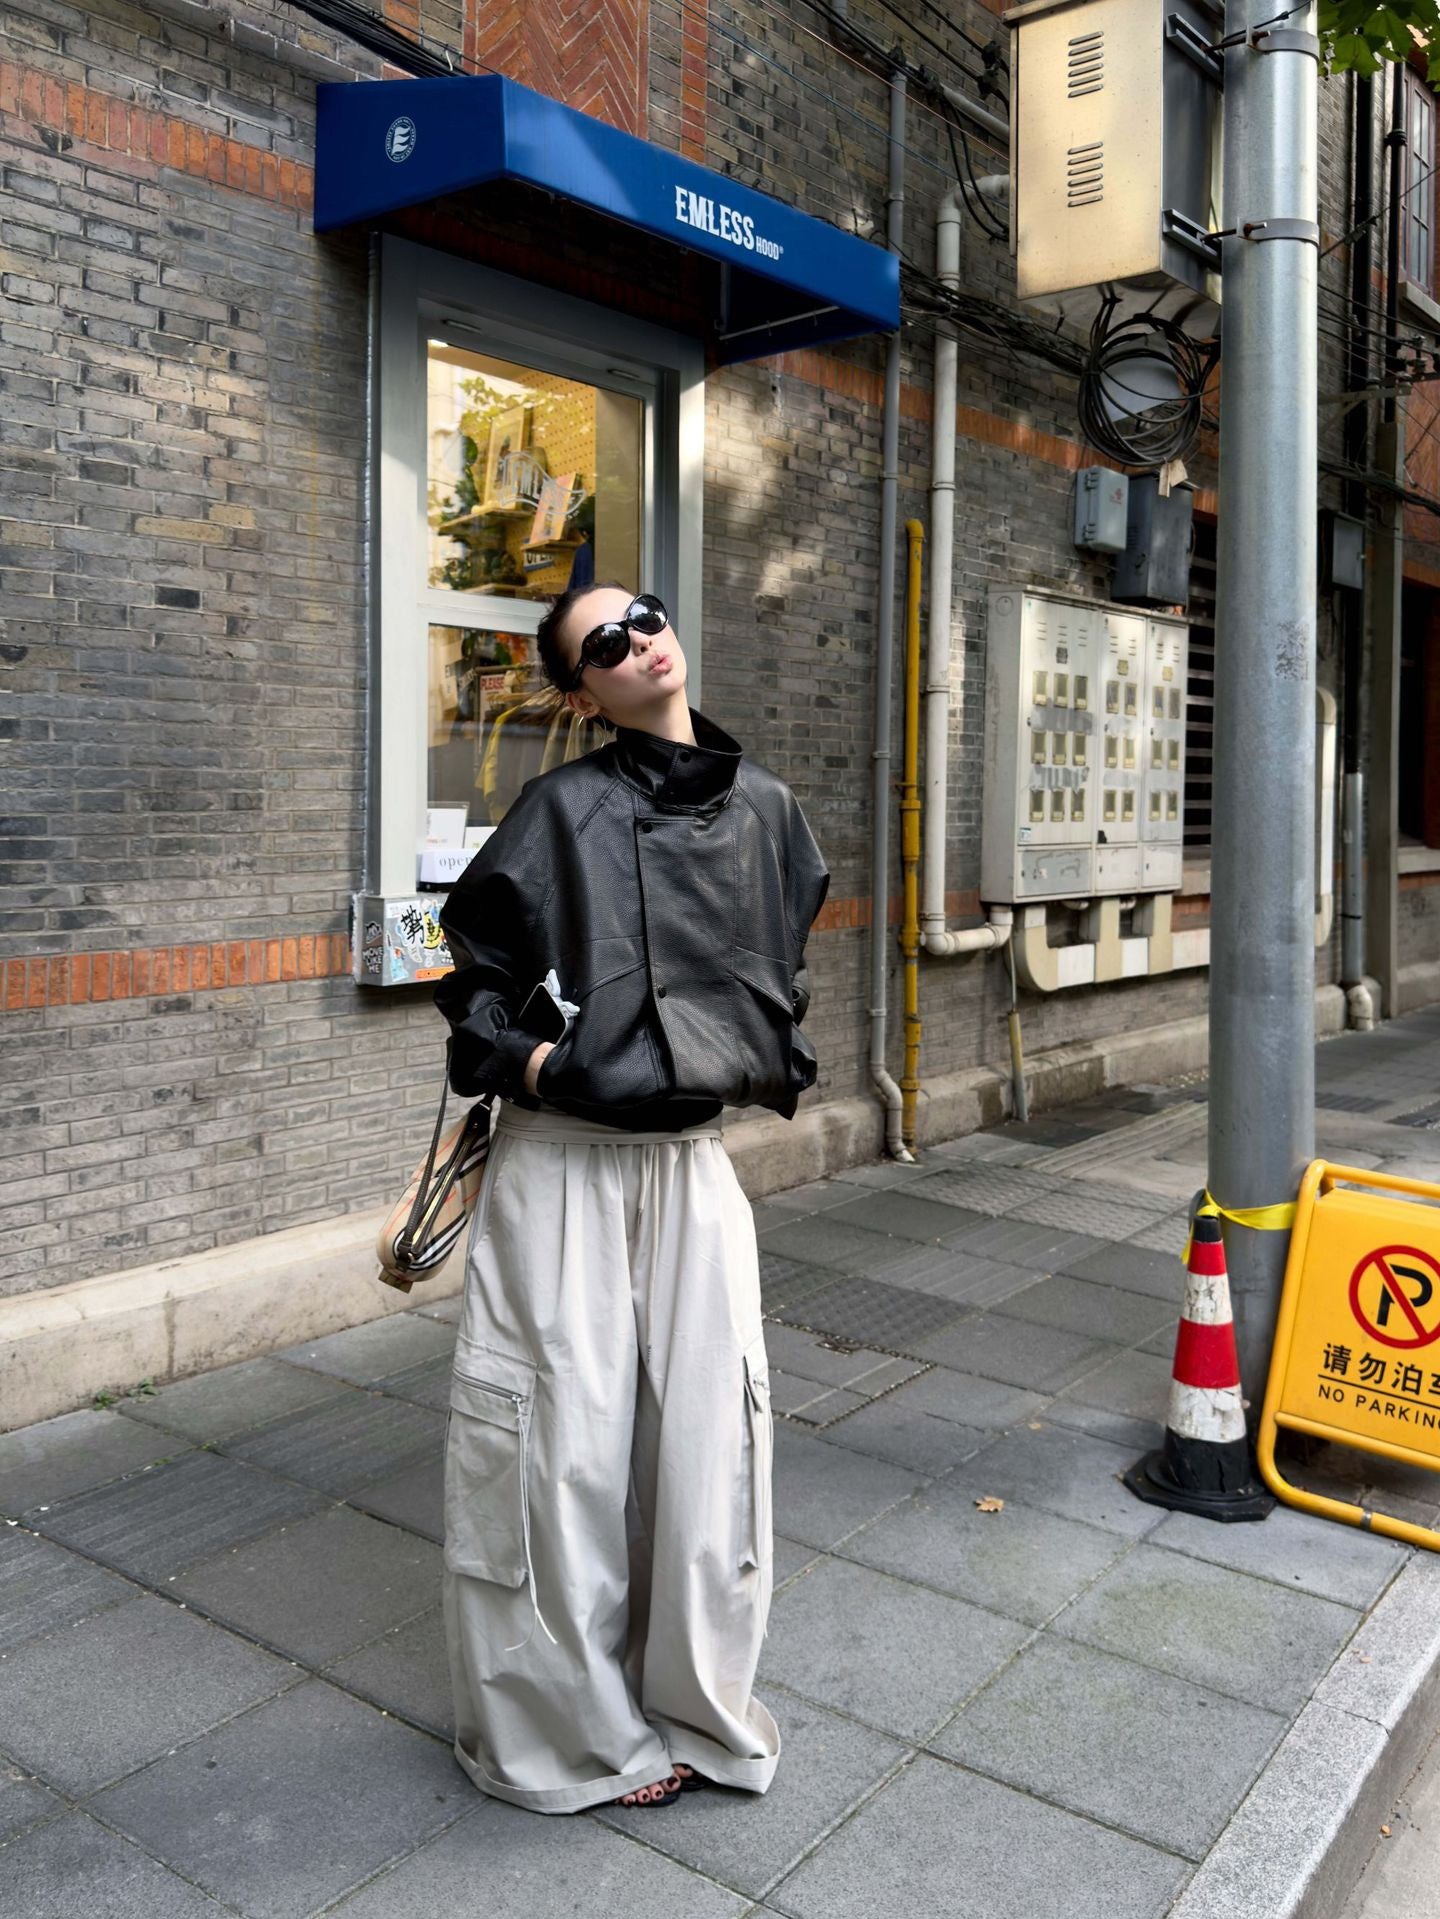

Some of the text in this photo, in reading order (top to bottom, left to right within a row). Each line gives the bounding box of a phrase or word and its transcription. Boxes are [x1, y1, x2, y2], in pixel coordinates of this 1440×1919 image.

[675, 185, 755, 250] EMLESS
[368, 964, 381, 974] ME
[1318, 1384, 1440, 1430] NO PARKIN
